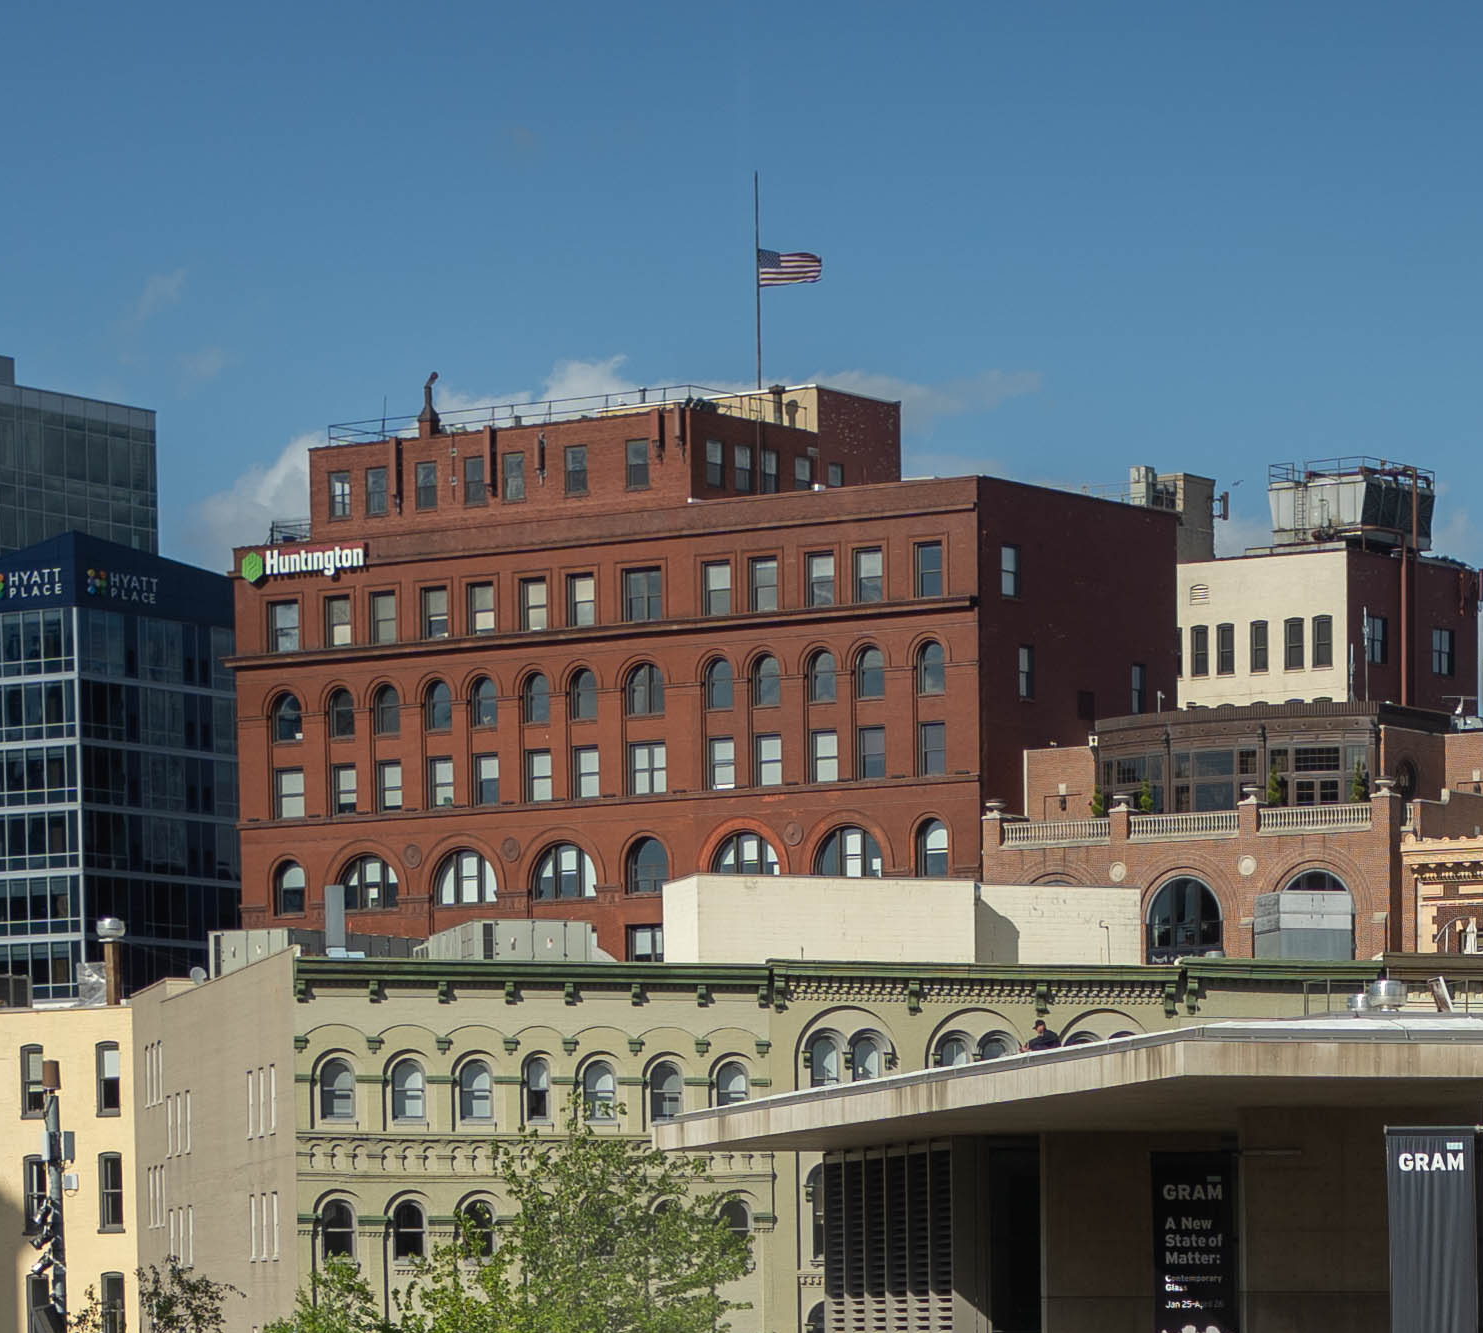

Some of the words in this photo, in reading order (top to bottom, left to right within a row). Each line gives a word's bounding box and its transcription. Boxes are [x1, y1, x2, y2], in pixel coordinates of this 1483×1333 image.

[265, 546, 365, 577] Huntington
[9, 567, 62, 586] HYATT
[110, 571, 158, 592] HYATT
[9, 583, 62, 599] PLACE
[111, 588, 157, 605] PLACE
[1398, 1152, 1465, 1172] GRAM
[1163, 1184, 1223, 1200] GRAM
[1165, 1217, 1176, 1230] A
[1181, 1217, 1212, 1230] New
[1165, 1234, 1206, 1247] State
[1208, 1233, 1223, 1247] of
[1165, 1252, 1221, 1265] Matter:
[1165, 1283, 1188, 1293] Glass
[1165, 1300, 1181, 1309] Jan
